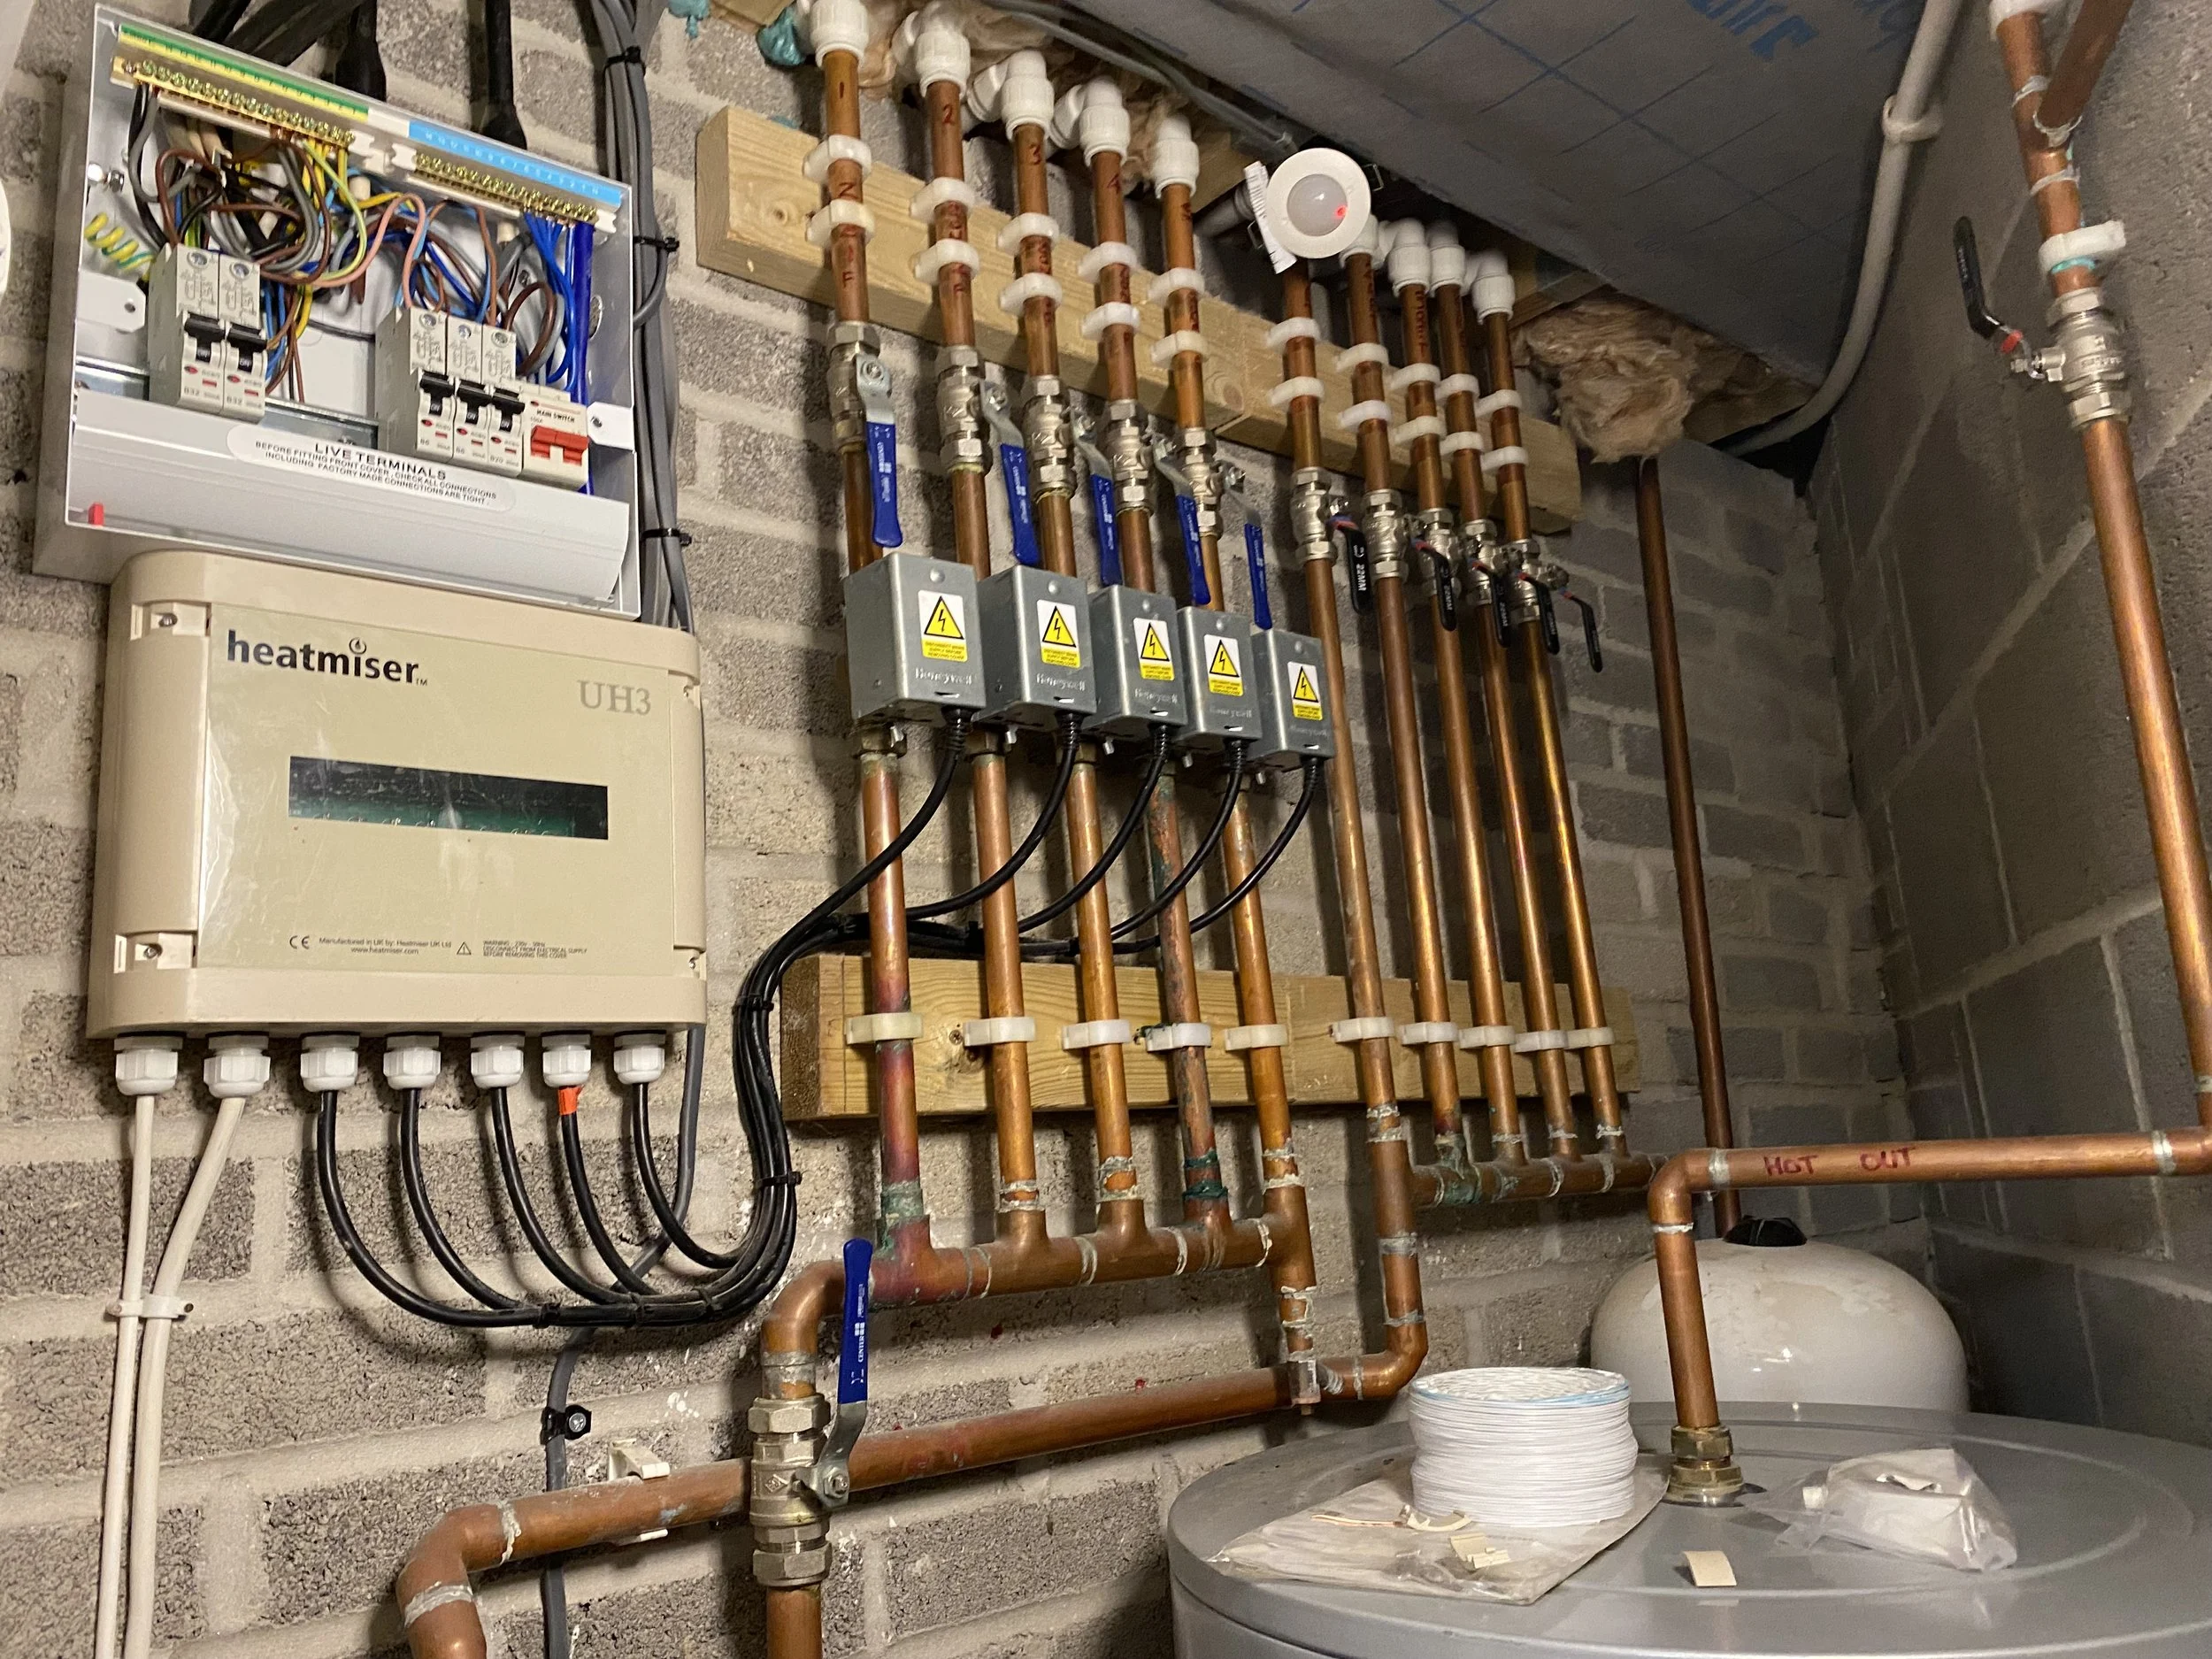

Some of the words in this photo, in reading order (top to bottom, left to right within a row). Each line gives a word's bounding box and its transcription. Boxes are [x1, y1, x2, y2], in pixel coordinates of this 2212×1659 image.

[942, 104, 953, 124] 2
[1030, 143, 1041, 165] 3
[1107, 173, 1120, 194] 4
[553, 412, 575, 423] SWITCH
[256, 441, 292, 456] BEFORE
[294, 449, 327, 463] FITTING
[330, 457, 358, 470] FRONT
[396, 472, 425, 484] CHECK
[425, 478, 438, 488] ALL
[440, 481, 496, 500] CONNECTIONS
[315, 442, 351, 460] LIVE
[356, 452, 447, 480] TERMINALS
[265, 451, 314, 468] INCLUDING
[318, 463, 357, 477] FACTORY
[359, 472, 383, 483] MADE
[384, 478, 443, 495] CONNECTIONS
[444, 490, 461, 500] ARE
[1357, 564, 1367, 592] 22MM
[227, 629, 419, 684] heatmiser
[577, 680, 651, 716] UH3
[350, 946, 419, 955] www.heatmiser.com
[1763, 1155, 1818, 1176] HOT
[1860, 1147, 1916, 1171] OUT
